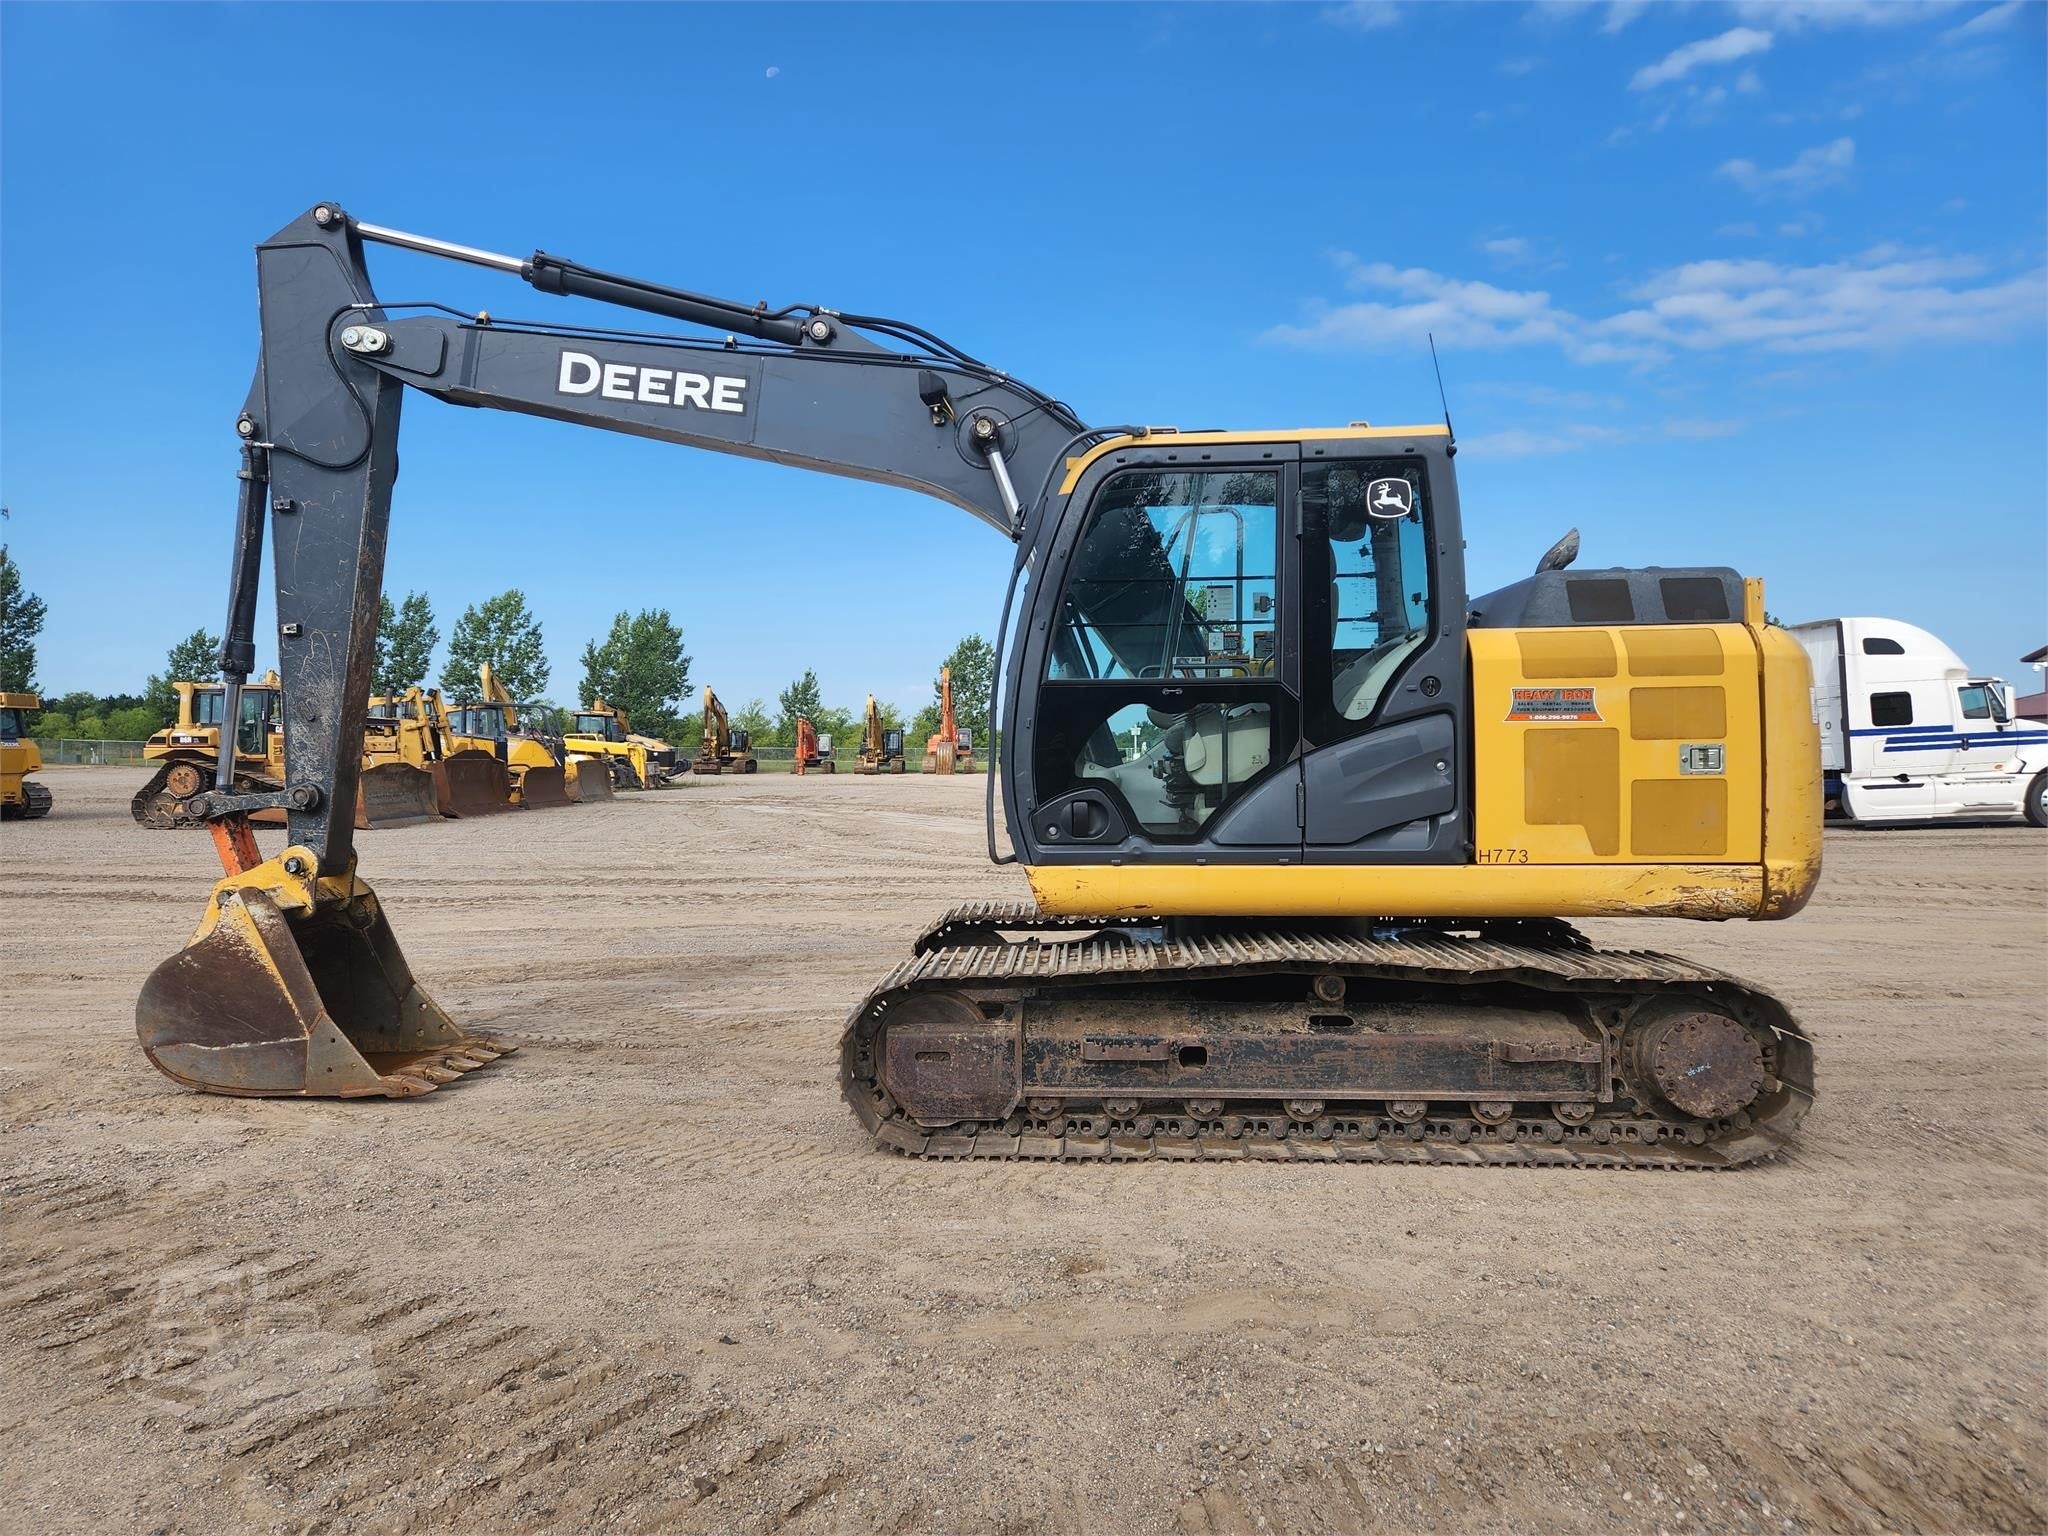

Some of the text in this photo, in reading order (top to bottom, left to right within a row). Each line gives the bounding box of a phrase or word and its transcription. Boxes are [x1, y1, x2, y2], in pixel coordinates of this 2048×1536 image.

[558, 351, 747, 413] DEERE
[1515, 689, 1592, 700] HEAVY IRON
[1478, 848, 1529, 864] H773
